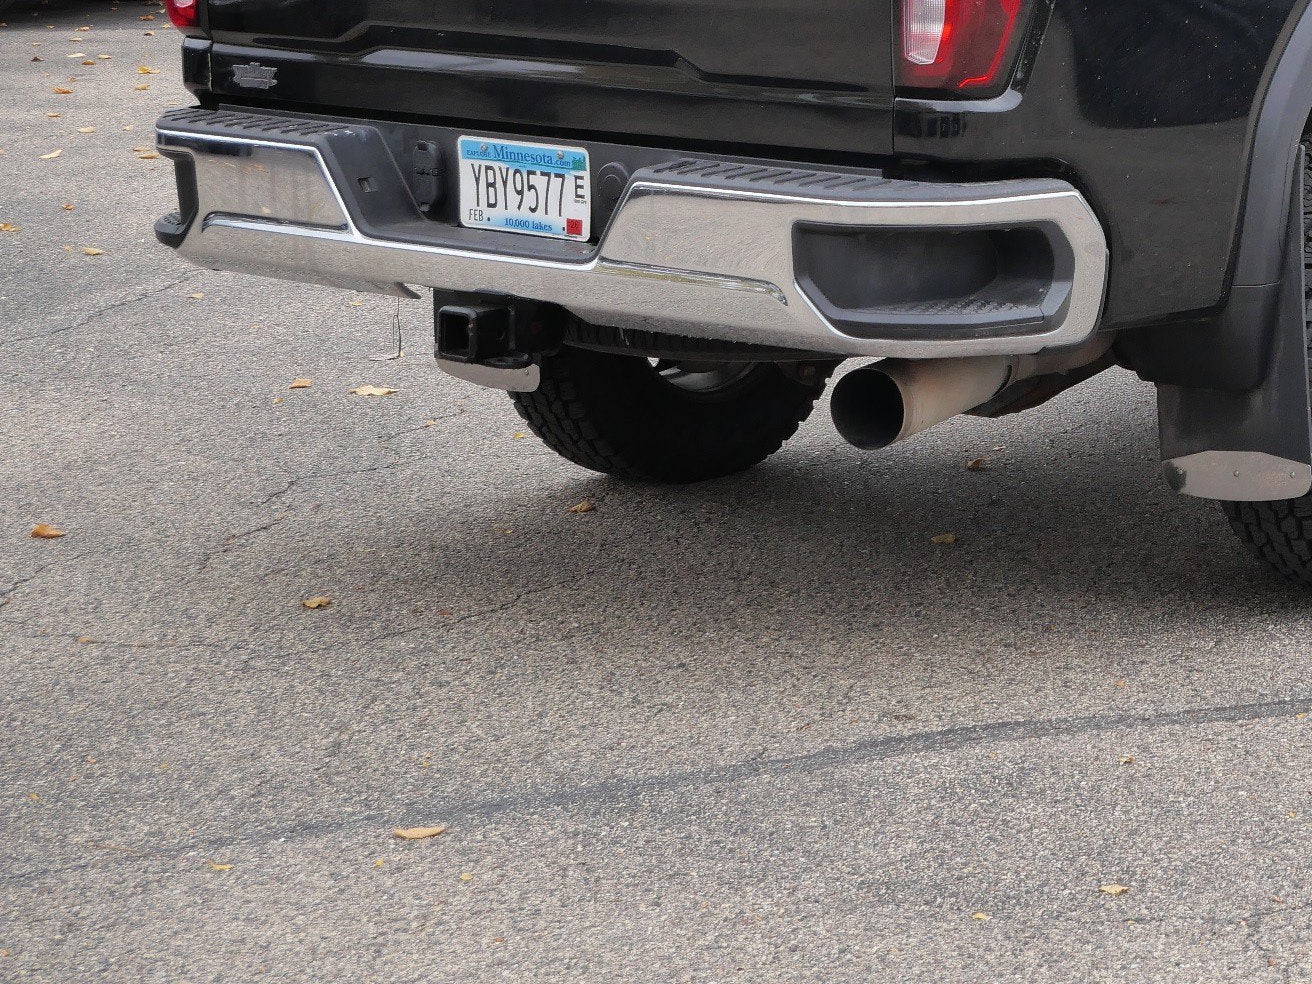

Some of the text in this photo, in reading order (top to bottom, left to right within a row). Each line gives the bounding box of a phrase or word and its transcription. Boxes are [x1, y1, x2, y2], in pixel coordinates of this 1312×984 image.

[471, 163, 566, 217] YBY9577
[573, 175, 586, 199] E
[468, 208, 484, 222] FEB
[504, 217, 553, 232] 10,000 lakes
